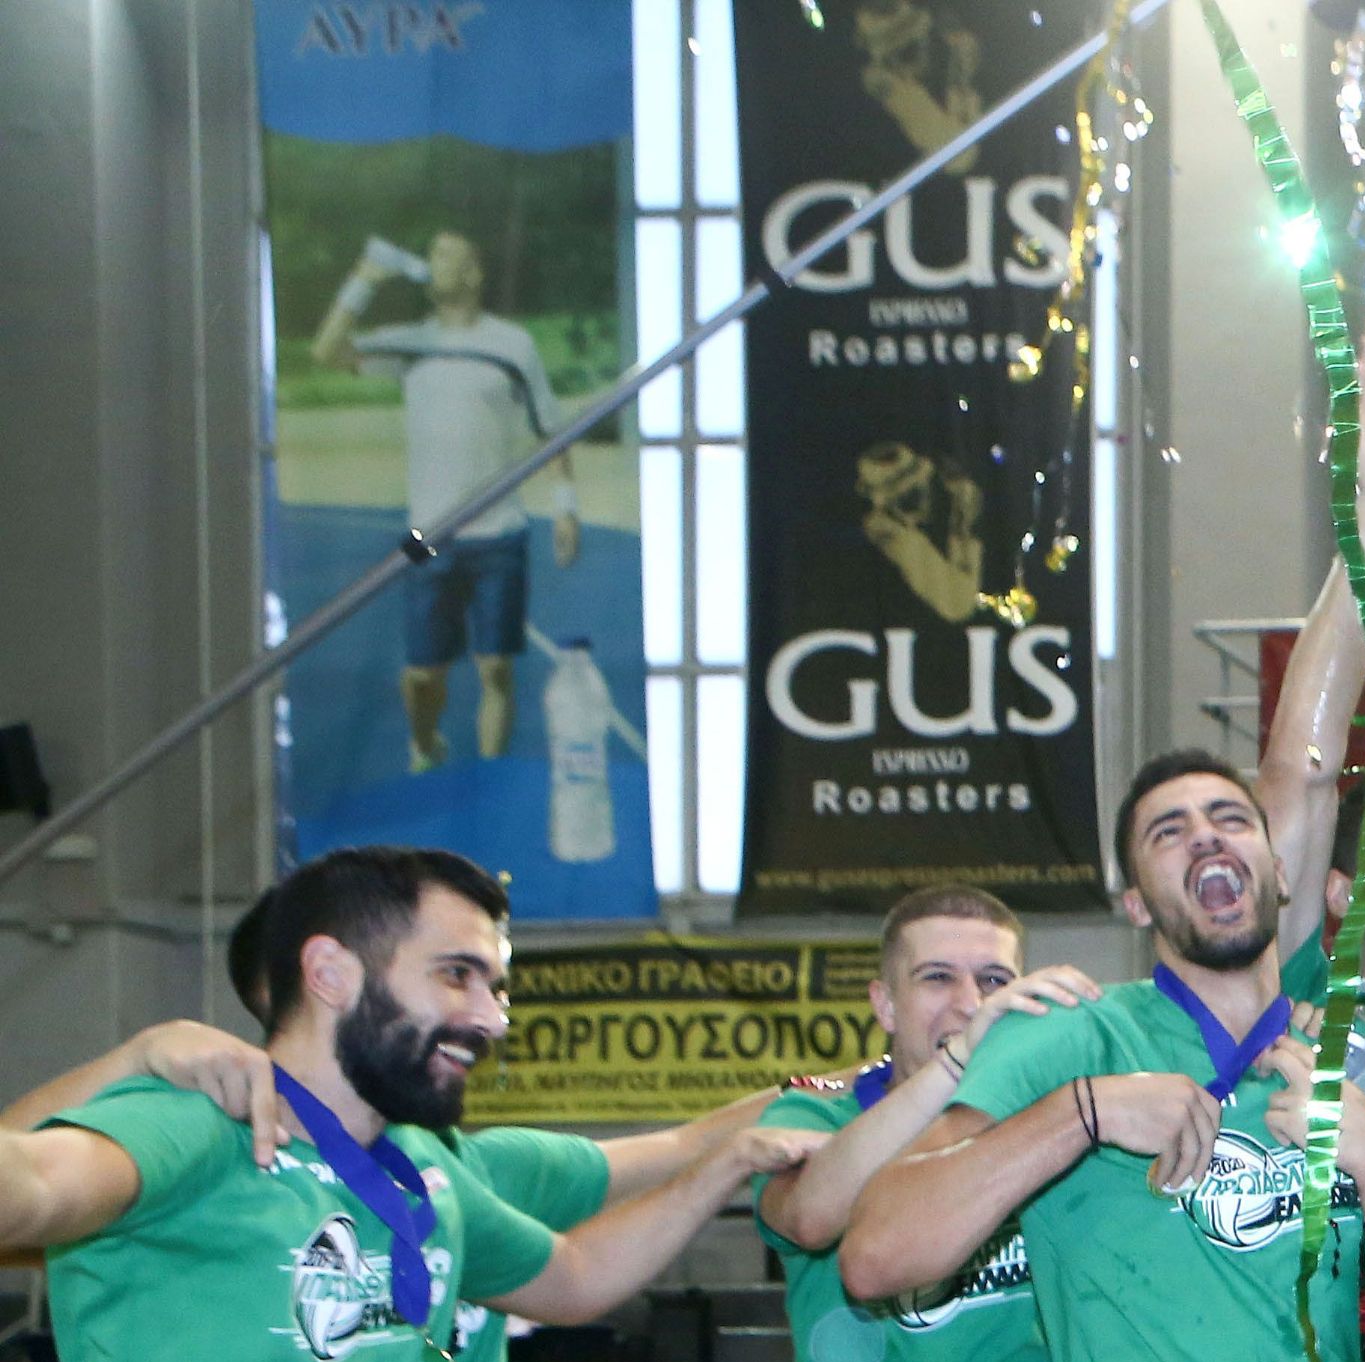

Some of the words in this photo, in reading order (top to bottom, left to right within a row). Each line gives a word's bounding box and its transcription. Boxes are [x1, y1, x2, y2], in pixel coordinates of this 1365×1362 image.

[762, 174, 1073, 293] GUS
[765, 624, 1079, 742] GUS
[812, 780, 1033, 816] Roasters
